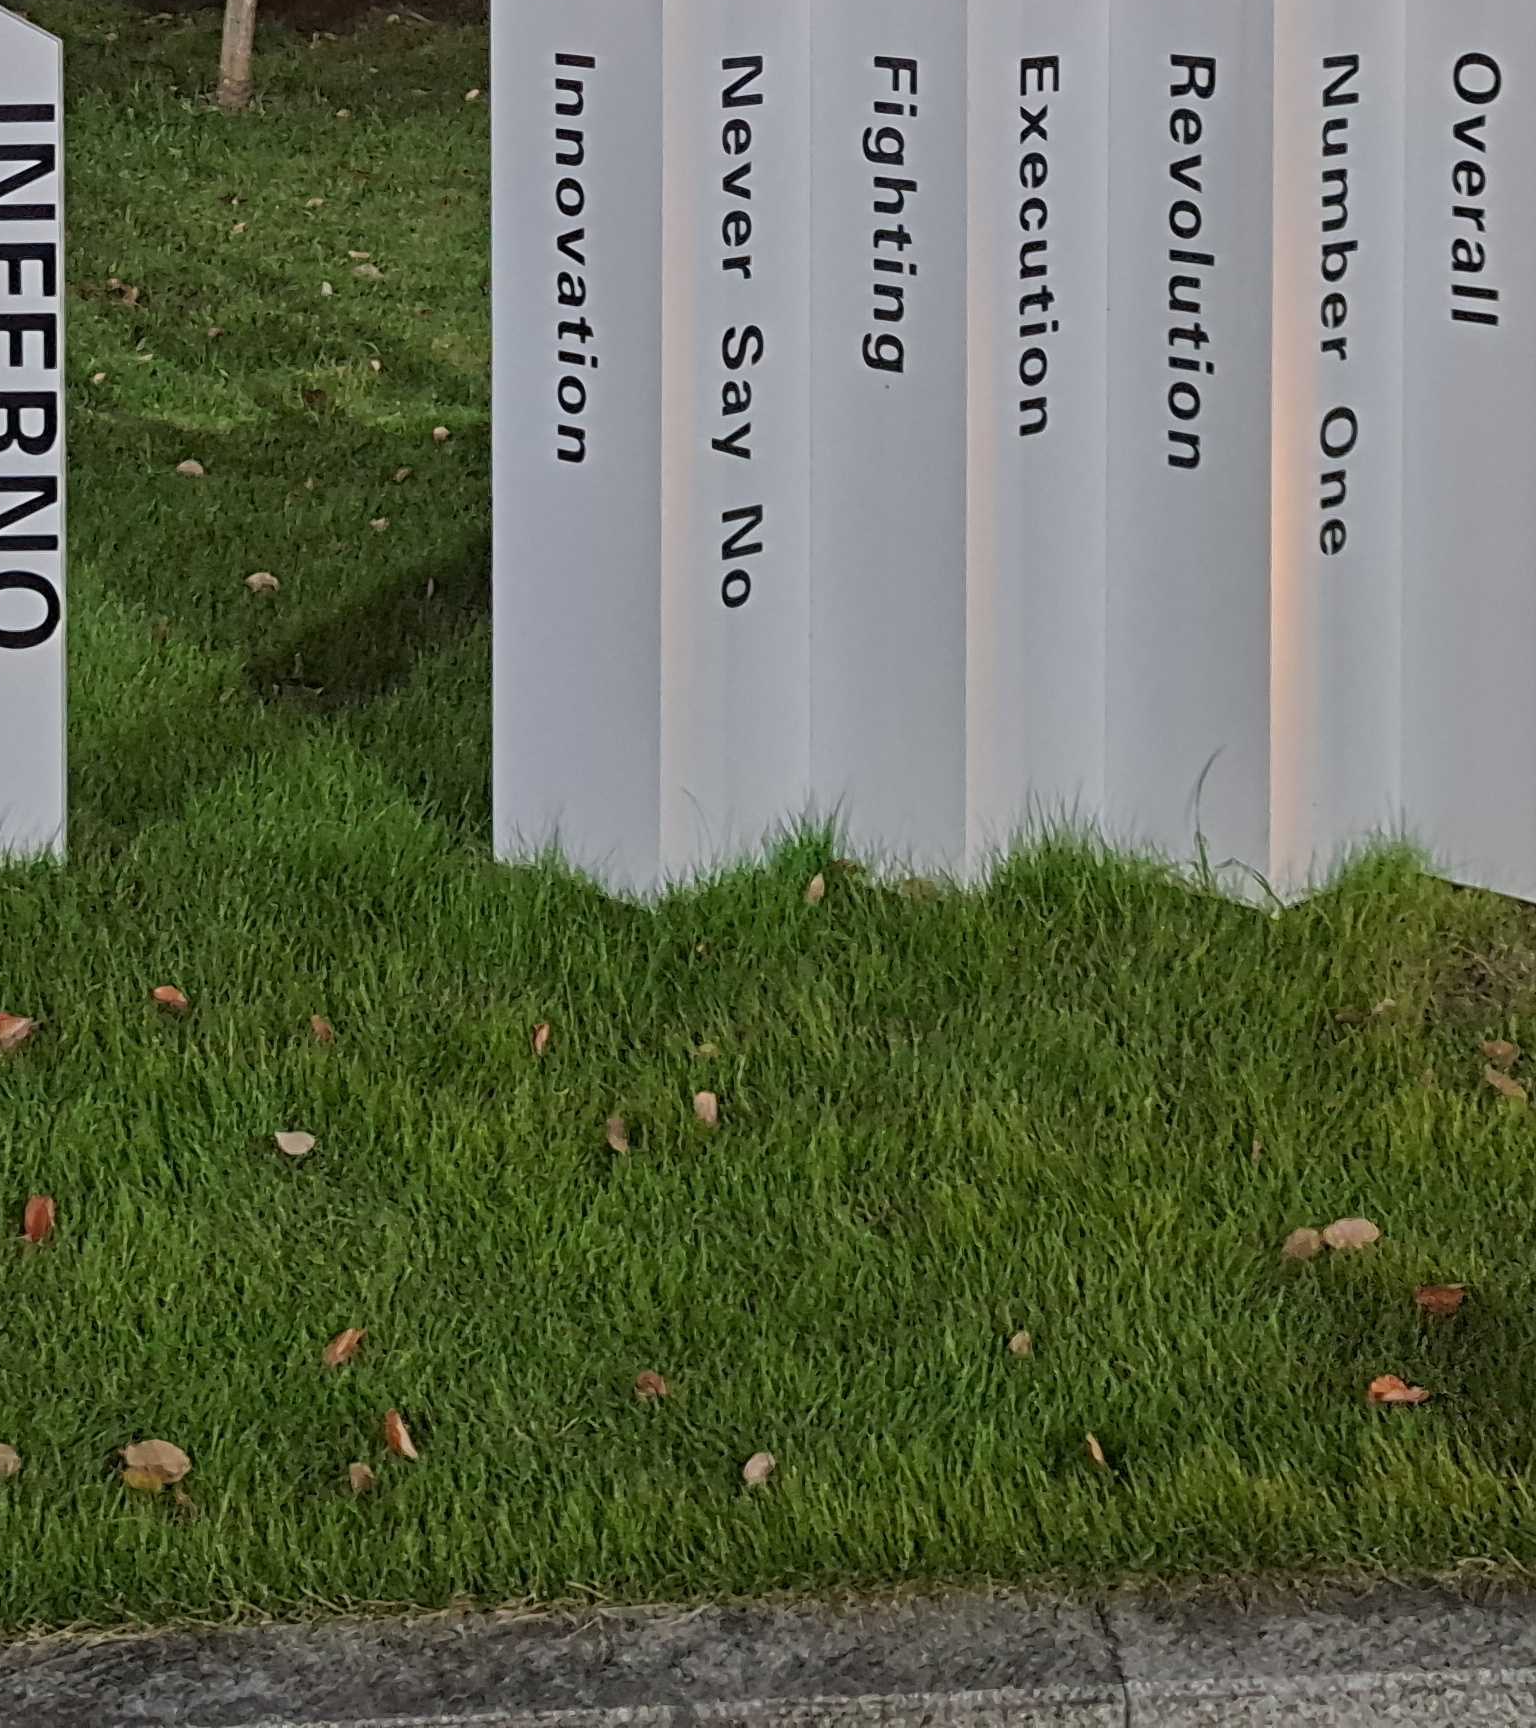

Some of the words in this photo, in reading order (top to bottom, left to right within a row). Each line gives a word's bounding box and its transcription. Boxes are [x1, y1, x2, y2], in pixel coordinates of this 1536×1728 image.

[553, 51, 600, 465] Innovation
[720, 54, 765, 281] Never
[860, 54, 919, 375] Fighting
[1017, 54, 1061, 438] Execution
[1166, 52, 1218, 471] Revolution
[1319, 53, 1361, 362] Number
[1450, 51, 1503, 328] Overall
[710, 323, 765, 461] Say
[1318, 405, 1360, 557] One
[720, 503, 764, 610] No
